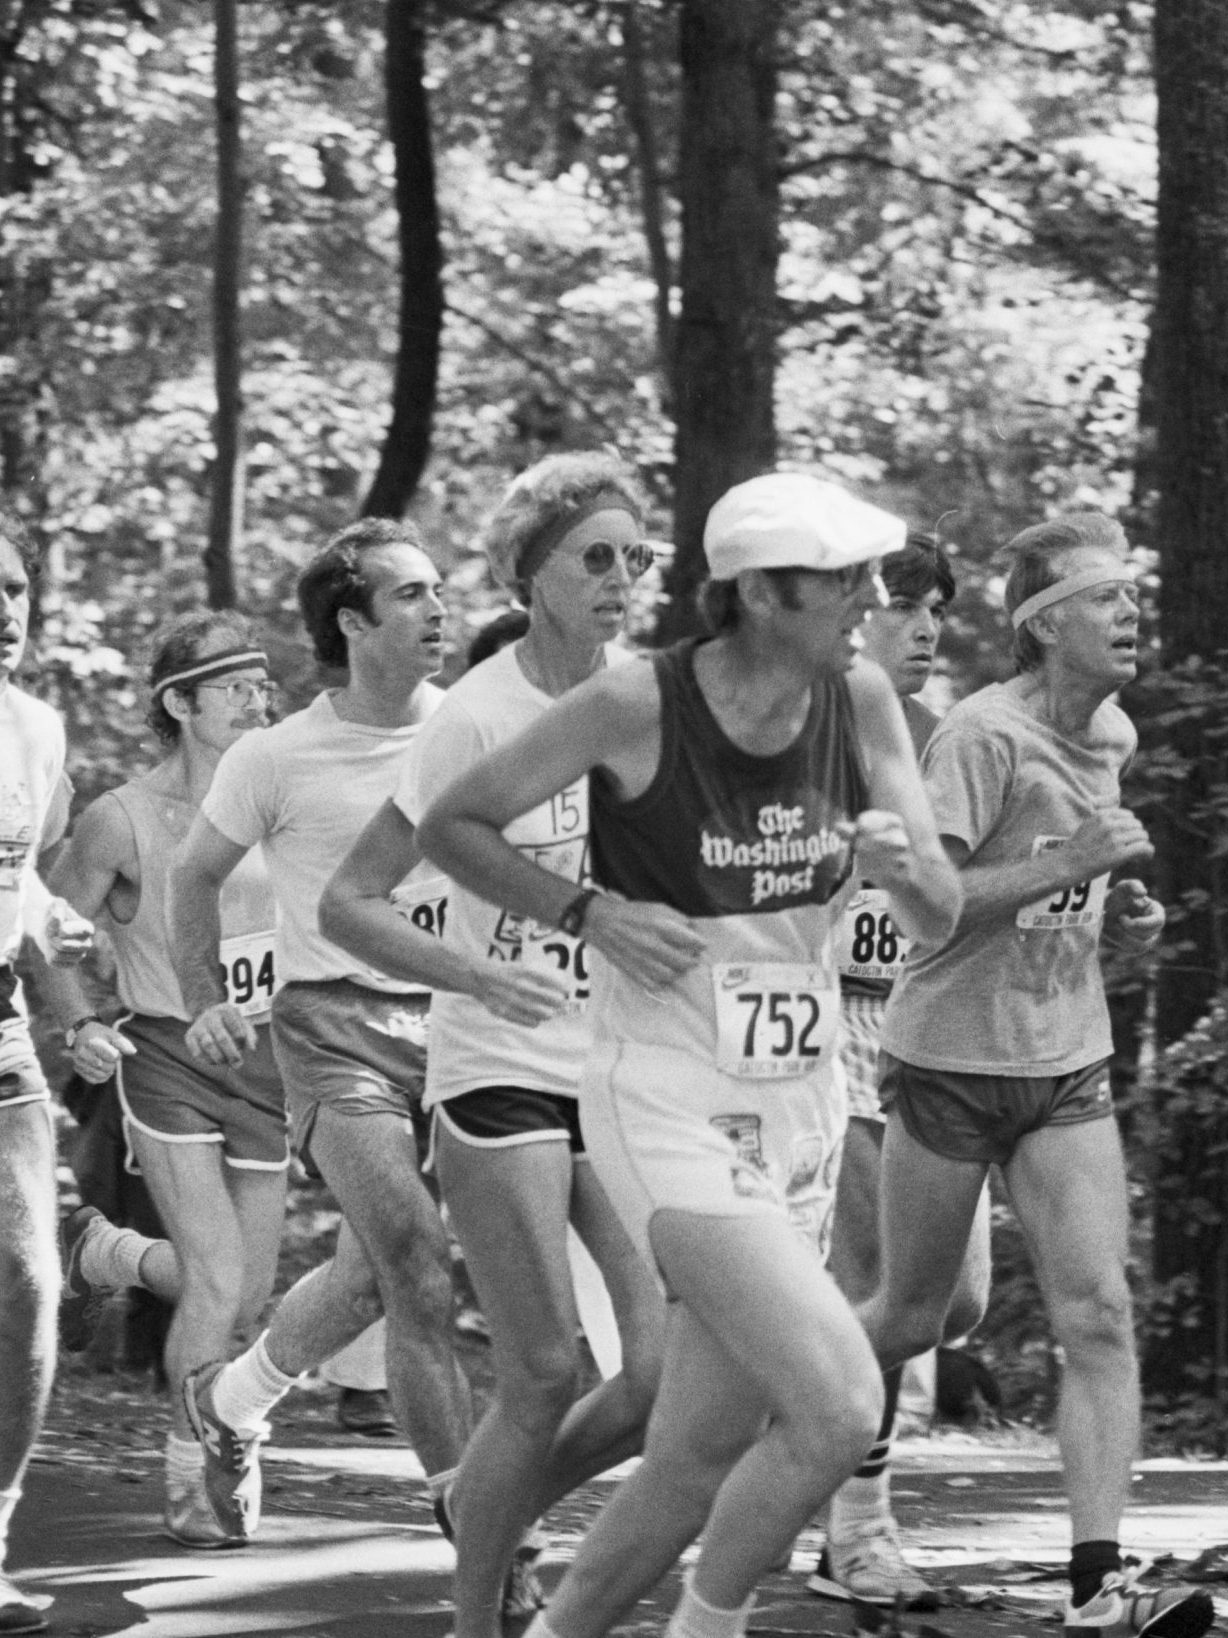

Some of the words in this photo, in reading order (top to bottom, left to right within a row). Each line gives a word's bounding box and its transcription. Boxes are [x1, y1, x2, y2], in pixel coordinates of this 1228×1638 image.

[551, 790, 581, 836] 15
[757, 802, 804, 835] The
[701, 826, 848, 868] Washingto
[752, 866, 814, 906] Post
[852, 911, 906, 965] 88
[737, 992, 821, 1057] 752
